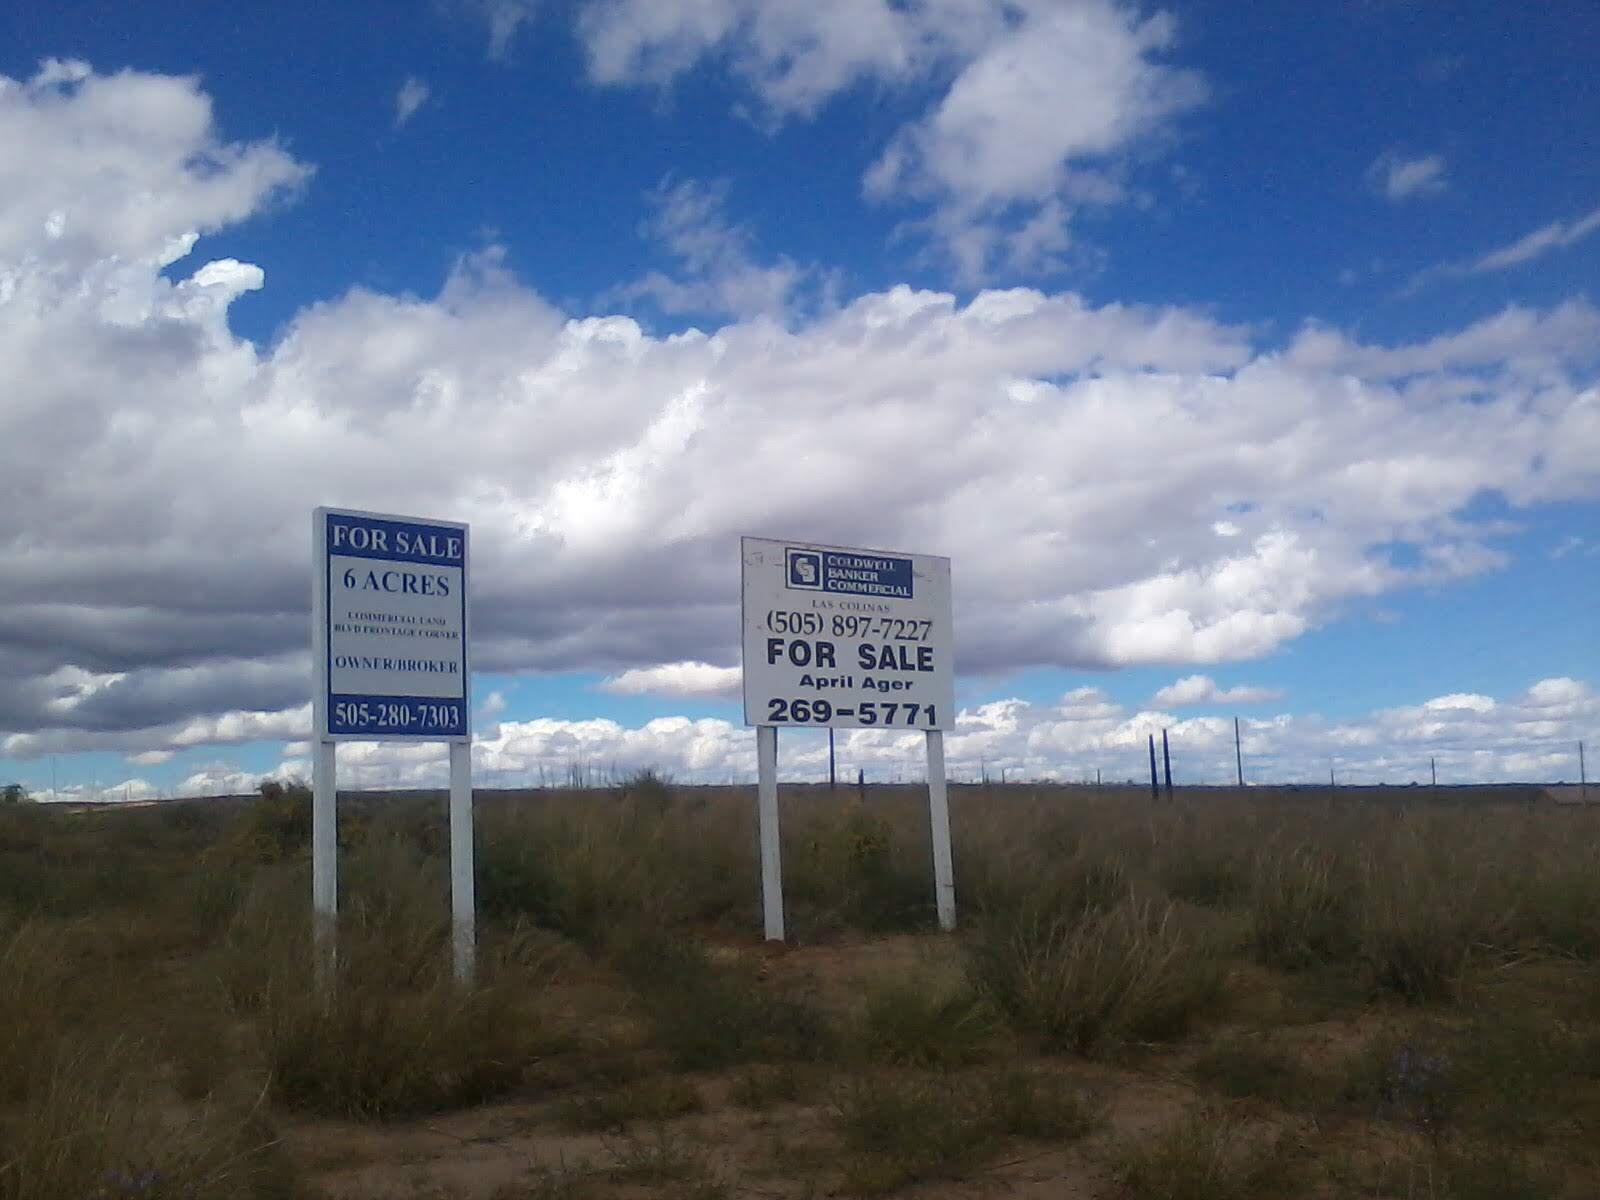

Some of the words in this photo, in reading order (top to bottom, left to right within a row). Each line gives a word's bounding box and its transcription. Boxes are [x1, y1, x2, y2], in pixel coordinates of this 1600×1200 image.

[333, 525, 389, 552] FOR
[396, 531, 462, 560] SALE
[827, 555, 898, 572] COLDWELL
[344, 568, 356, 589] 6
[362, 570, 450, 597] ACRES
[827, 567, 879, 583] BANKER
[827, 579, 911, 597] COMMERCIAL
[812, 600, 834, 609] LAS
[839, 602, 891, 613] COLINAS
[347, 611, 416, 625] COMMERCIAL
[767, 610, 824, 635] (505)
[832, 615, 933, 643] 897-7227
[363, 624, 415, 638] FRONTAGE
[418, 630, 459, 641] CORNER
[335, 655, 458, 674] OWNER/BROKER
[767, 638, 836, 669] FOR
[858, 643, 935, 673] SALE
[799, 674, 854, 691] April
[861, 676, 914, 693] Ager
[335, 702, 459, 729] 505-280-7303
[767, 698, 937, 727] 269-5771
